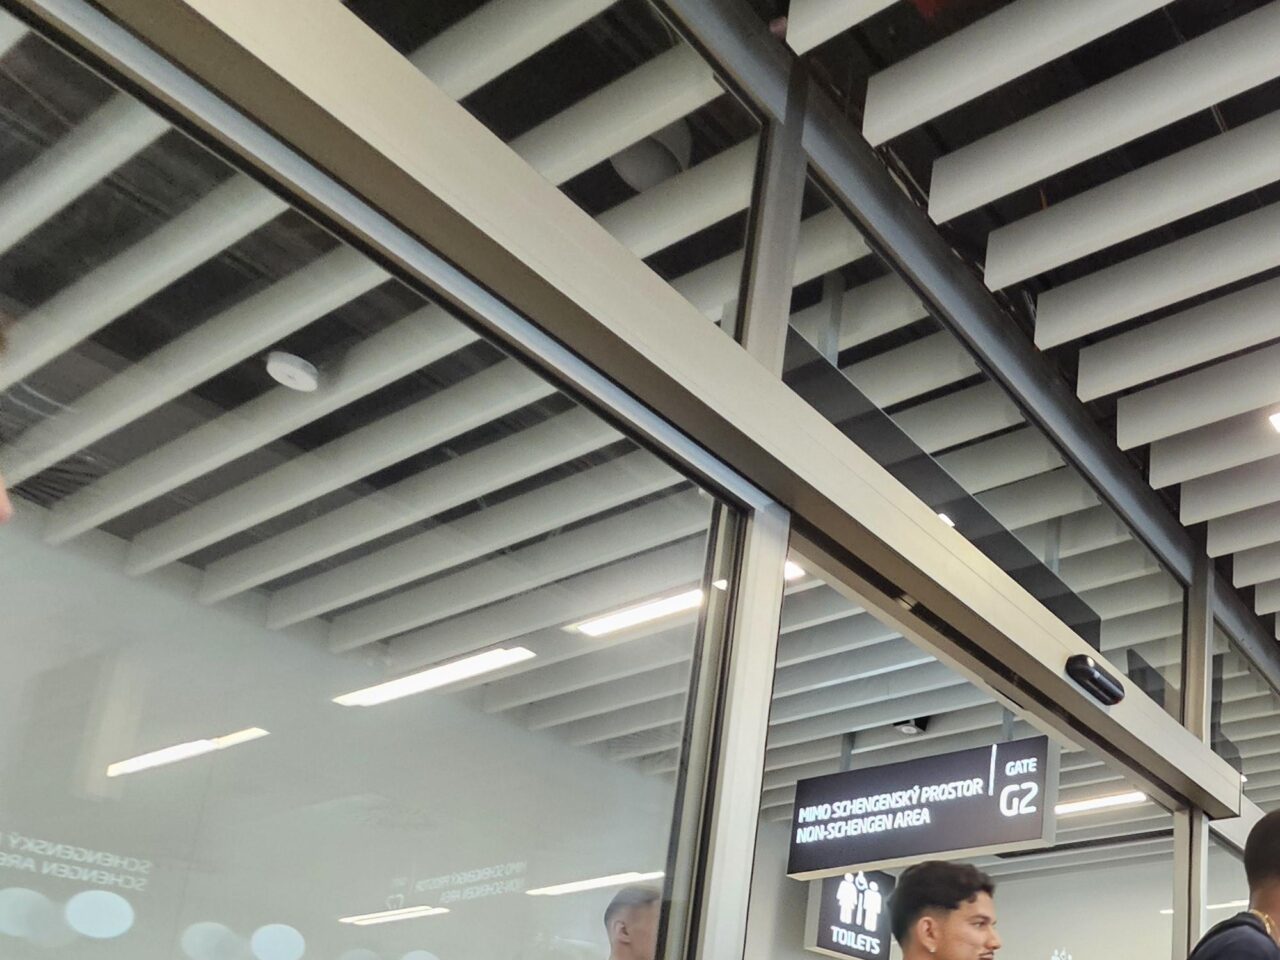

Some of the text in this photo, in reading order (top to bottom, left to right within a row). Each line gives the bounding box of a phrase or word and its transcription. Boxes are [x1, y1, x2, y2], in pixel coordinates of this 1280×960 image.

[1005, 757, 1038, 776] GATE
[798, 778, 984, 823] MIMO SCHENGENSKÝ PROSTOR
[999, 781, 1039, 817] G2
[796, 808, 931, 843] NON-SCHENGEN AREA
[830, 925, 880, 955] TOILETS
